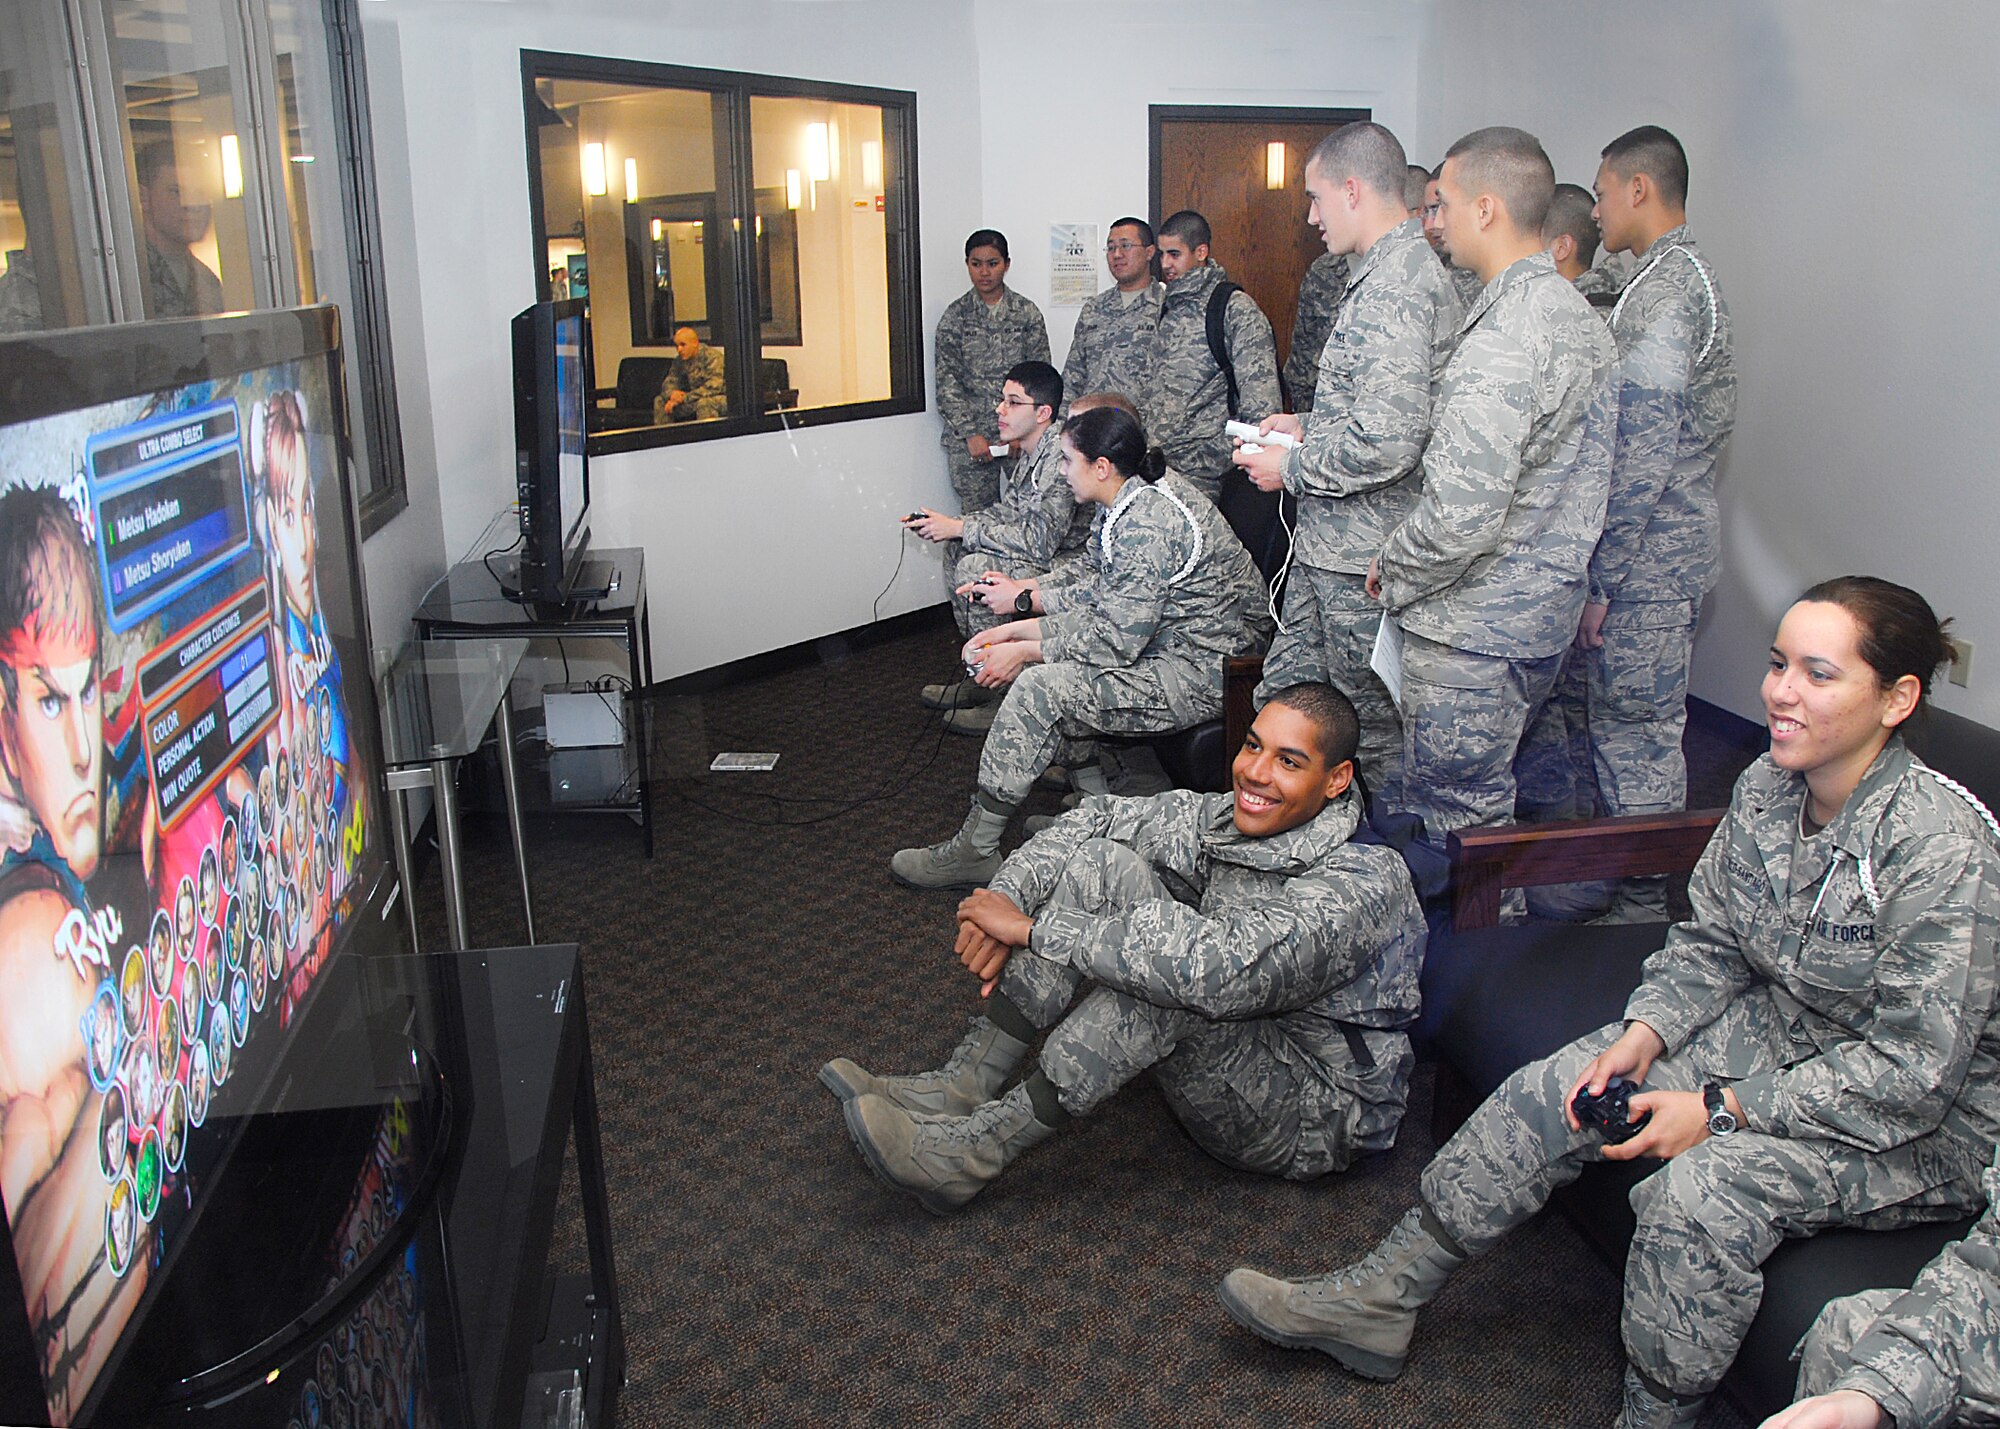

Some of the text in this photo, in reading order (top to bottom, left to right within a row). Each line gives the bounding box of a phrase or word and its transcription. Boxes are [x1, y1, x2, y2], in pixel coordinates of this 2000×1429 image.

[138, 424, 203, 460] ULTRA COMBO SELECT
[117, 515, 145, 543] Metsu
[145, 499, 180, 530] Hadoken
[124, 561, 150, 588] Metsu
[152, 540, 191, 574] Shoryuken
[179, 609, 240, 667] CHARACTER CUSTOMIZE
[153, 709, 179, 744] COLOR
[158, 711, 215, 778] PERSONAL ACTION
[162, 756, 202, 807] WIN QUOTE
[54, 903, 123, 982] Ryu
